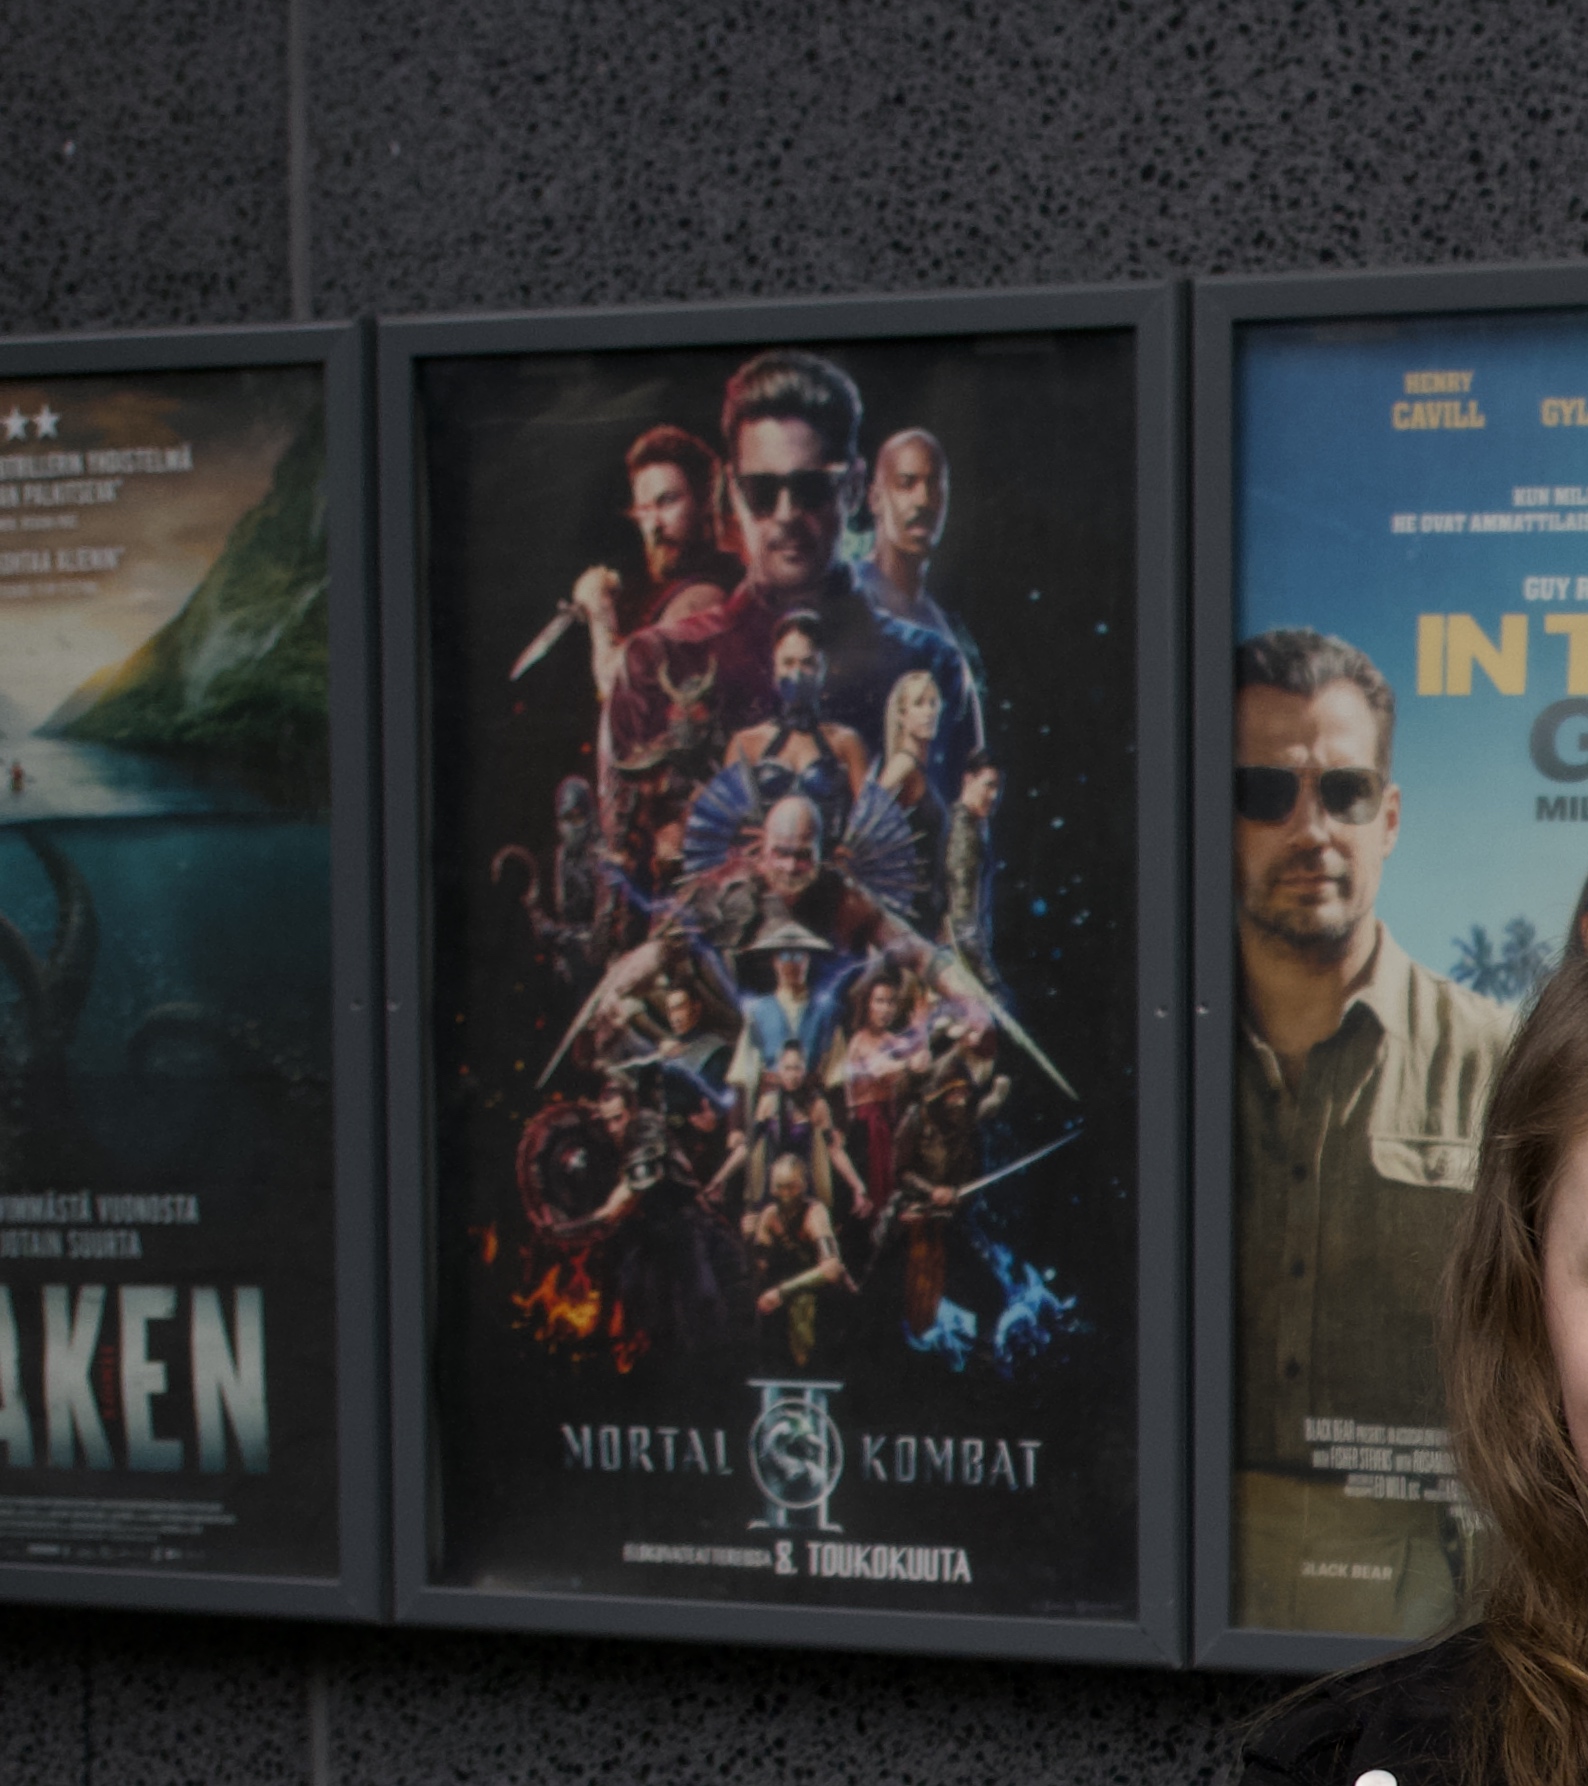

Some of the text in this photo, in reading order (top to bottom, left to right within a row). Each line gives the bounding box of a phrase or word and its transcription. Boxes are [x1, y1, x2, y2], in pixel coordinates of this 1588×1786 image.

[1405, 371, 1473, 394] HENRY
[1392, 401, 1485, 429] CAVILL
[1513, 487, 1550, 506] KUN
[1391, 514, 1417, 533] HE
[1421, 513, 1465, 533] OVAT
[1523, 576, 1569, 601] GUY
[1416, 614, 1528, 696] IN
[562, 1424, 1042, 1491] MORTAL KOMBAT
[808, 1542, 971, 1583] TOUKOKUUTA
